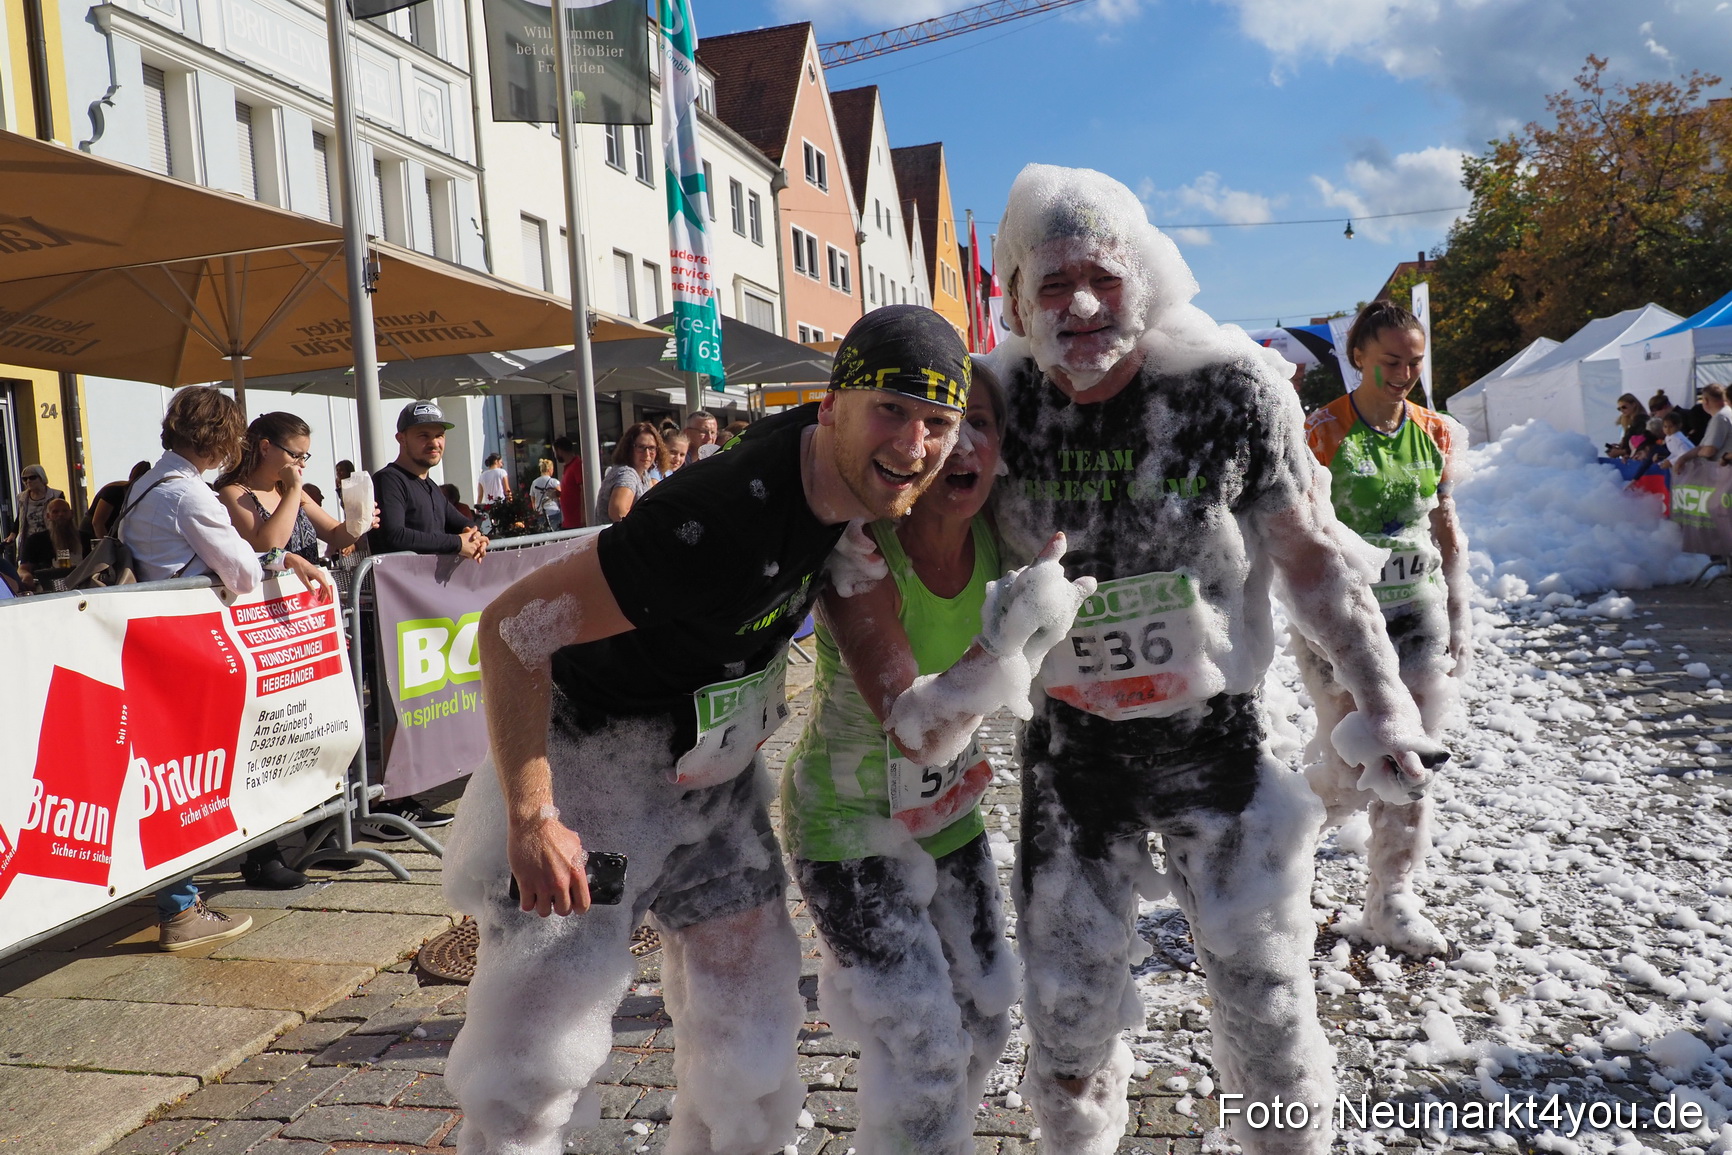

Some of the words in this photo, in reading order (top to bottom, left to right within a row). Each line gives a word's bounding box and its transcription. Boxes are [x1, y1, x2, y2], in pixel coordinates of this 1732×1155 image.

[524, 26, 613, 40] Willmmen
[516, 43, 536, 55] bei
[541, 44, 556, 56] de
[573, 44, 624, 57] BioBier
[538, 60, 605, 74] Frenden
[666, 49, 691, 76] GmbH
[40, 402, 58, 419] 24
[1058, 449, 1134, 472] TEAM
[236, 598, 302, 622] BINDESTRICKE
[210, 628, 229, 652] 1929
[1071, 621, 1173, 673] 536
[262, 667, 314, 693] HEBEBÄNDER
[119, 704, 128, 726] 1929
[258, 708, 284, 722] Braun
[287, 699, 307, 716] GmbH
[401, 692, 459, 729] inspired
[462, 689, 477, 712] by
[250, 735, 287, 752] D-92318
[287, 719, 349, 745] Neumarkt-Pölling
[253, 724, 270, 737] Am
[272, 716, 308, 734] Grünberg
[309, 712, 313, 725] 8
[247, 759, 260, 774] Tel.
[261, 753, 287, 769] 09181
[294, 745, 321, 762] 2307-0
[136, 748, 226, 820] Braun
[246, 776, 261, 790] Fax
[23, 778, 110, 846] Braun
[179, 809, 202, 828] Sicher
[208, 796, 230, 812] sicher
[51, 842, 78, 859] Sicher
[79, 847, 91, 861] ist
[92, 850, 113, 865] sicher
